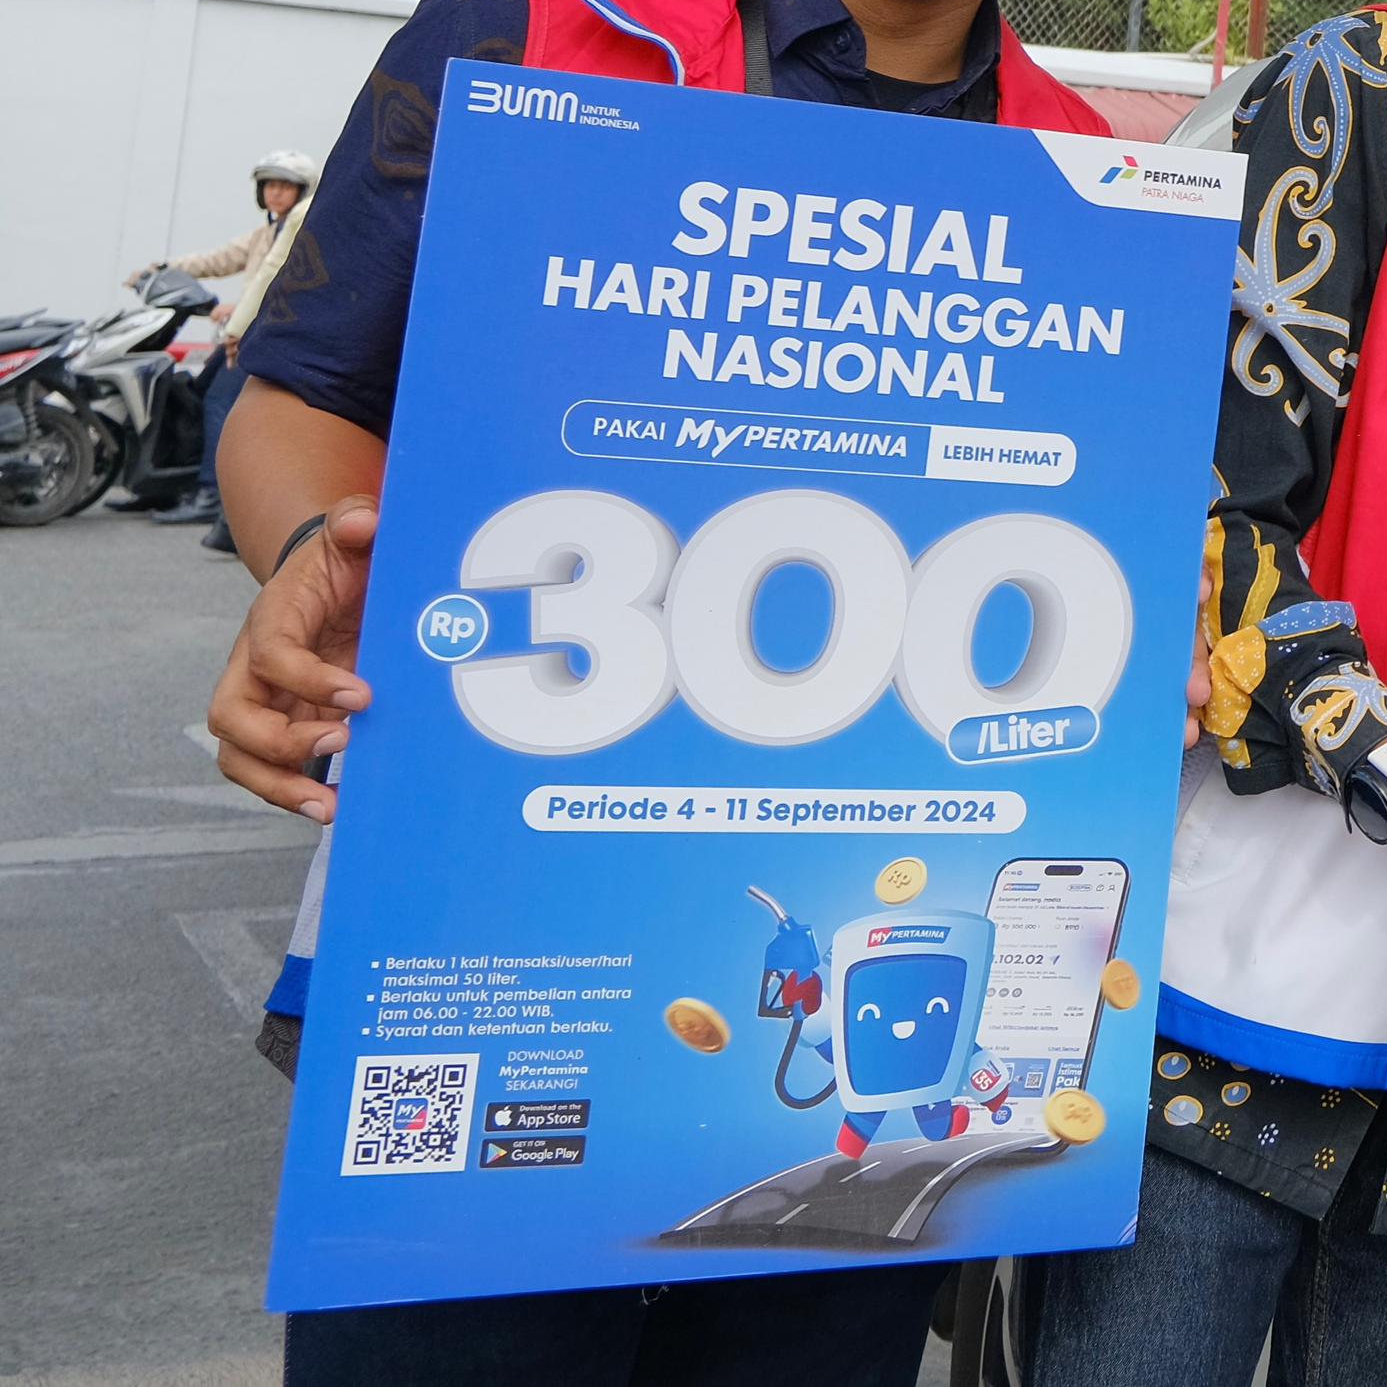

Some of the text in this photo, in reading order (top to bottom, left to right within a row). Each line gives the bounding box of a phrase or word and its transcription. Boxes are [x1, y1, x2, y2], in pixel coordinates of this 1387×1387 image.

[467, 80, 579, 123] BUMN
[581, 104, 621, 118] UNTUK
[579, 115, 640, 131] INDONESIA
[1143, 170, 1222, 190] PERTAMINA
[1141, 187, 1204, 203] PATRA NIAGA
[671, 181, 1023, 284] SPESIAL
[543, 256, 1124, 355] HARI PELANGGAN
[663, 328, 1005, 403] NASIONAL
[593, 417, 1062, 467] PAKAI MyPERTAMINA LEBIH HEMAT
[429, 488, 1133, 755] Rp 300
[977, 714, 1071, 755] /Liter
[547, 795, 668, 821] Periode
[677, 799, 695, 820] 4
[726, 798, 748, 821] 11
[756, 798, 916, 826] September
[924, 800, 996, 823] 2024
[386, 954, 632, 970] Berlaku 1 kali transaksi/user/hari
[383, 972, 521, 987] maksimal 50 liter.
[381, 988, 632, 1004] Berlaku untuk pembelian antara
[377, 1007, 408, 1023] jam
[413, 1007, 458, 1020] 06.00
[473, 1006, 517, 1019] 22.00
[521, 1005, 555, 1018] WIB.
[375, 1021, 613, 1040] Syarat dan ketentuan berlaku.
[507, 1049, 584, 1062] DOWNLOAD
[499, 1065, 588, 1079] MyPertamina
[505, 1078, 578, 1091] SEKARANG!
[517, 1113, 581, 1127] App Store
[511, 1148, 579, 1162] Google Play
